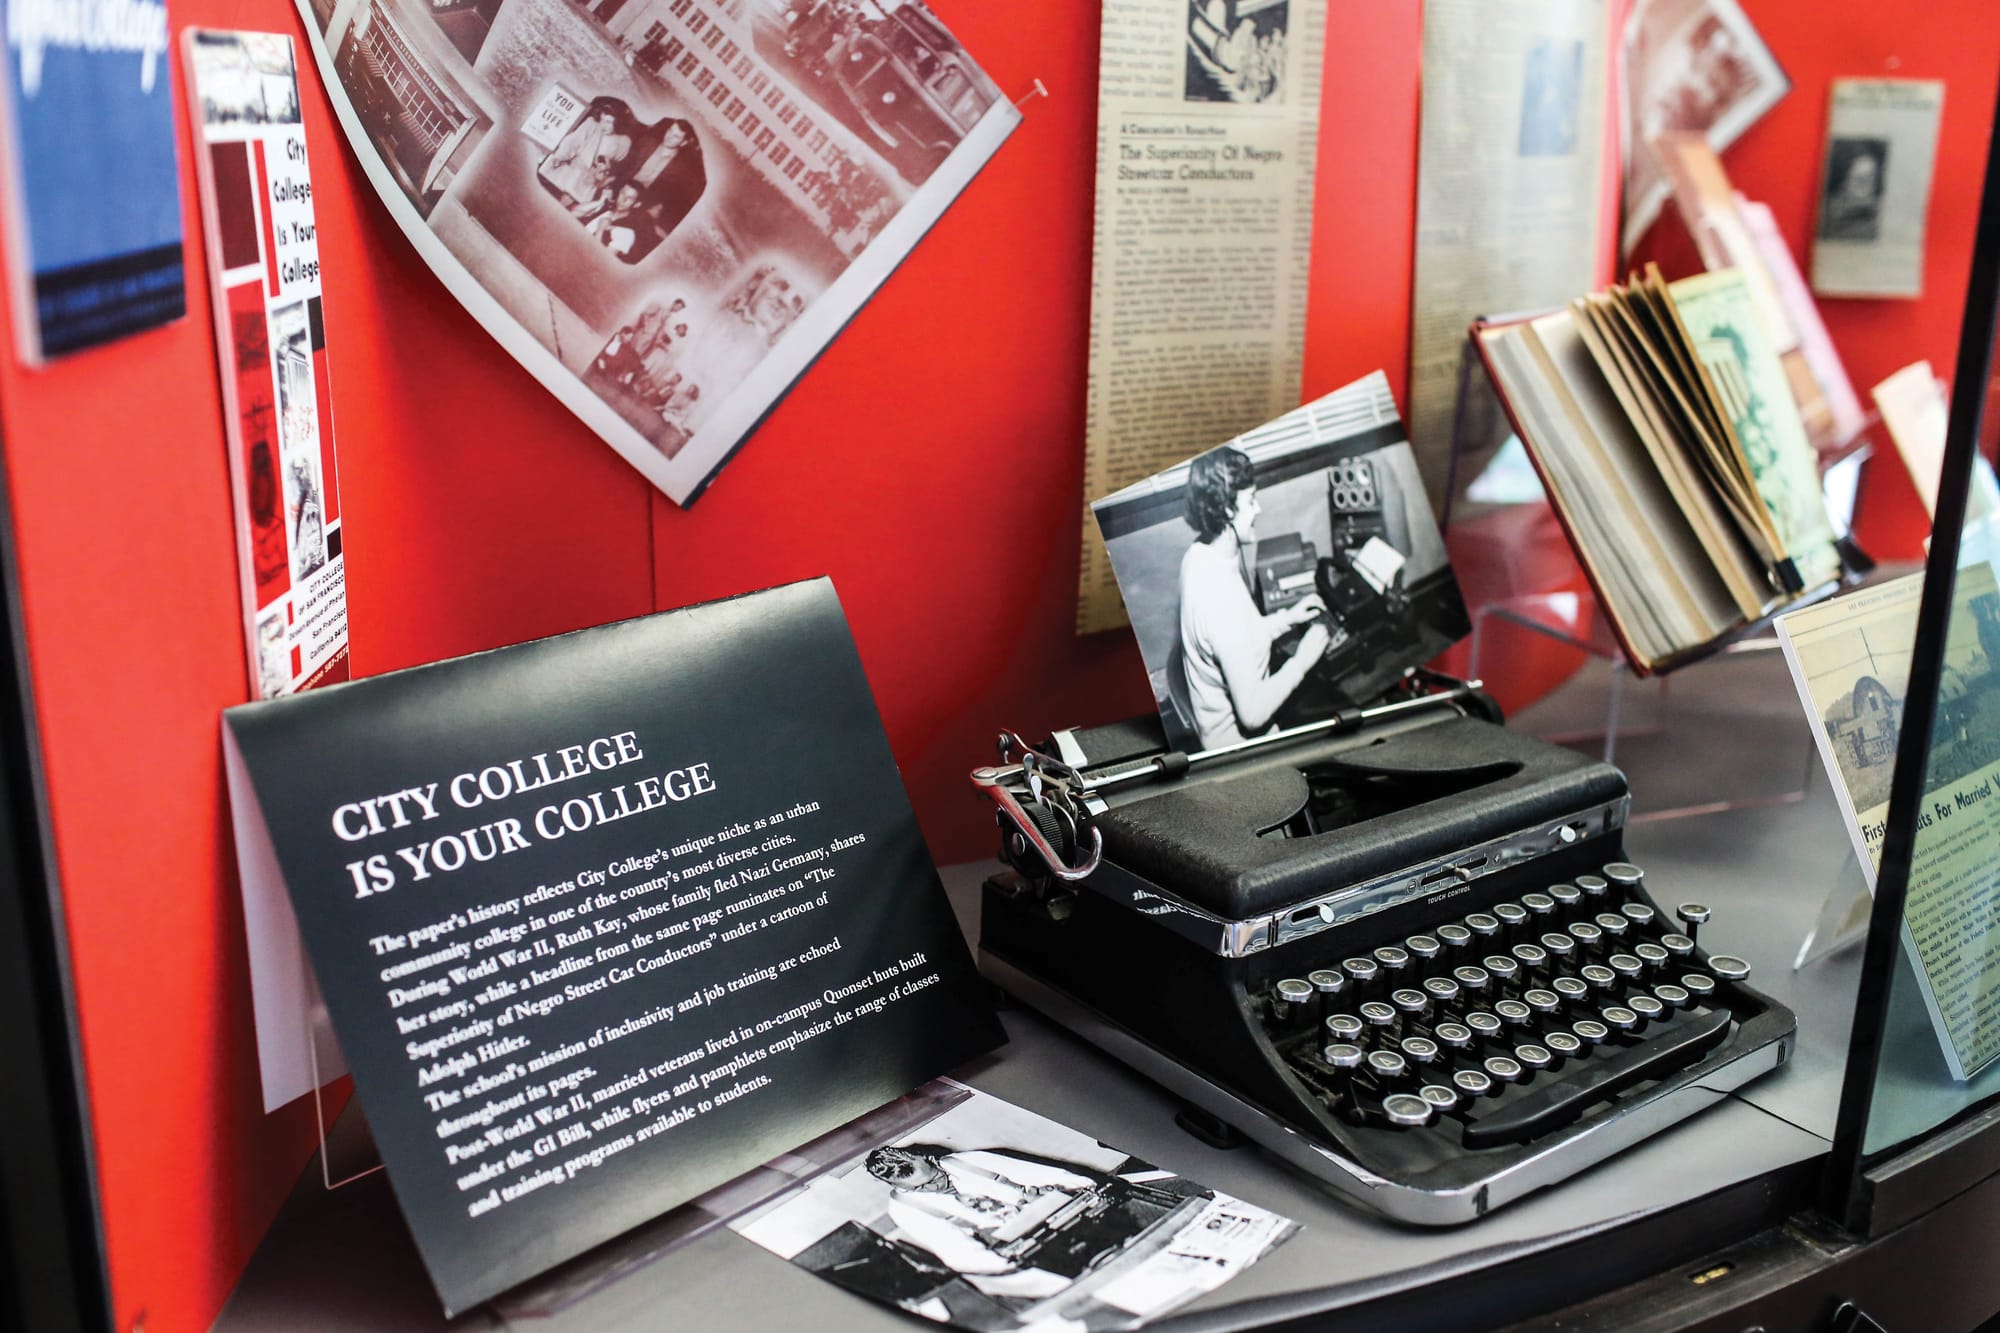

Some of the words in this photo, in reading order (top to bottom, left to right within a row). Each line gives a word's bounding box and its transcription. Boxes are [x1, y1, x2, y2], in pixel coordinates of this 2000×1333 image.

[542, 109, 562, 128] LIFE
[555, 92, 574, 111] YOU
[274, 177, 311, 204] College
[287, 138, 305, 165] City
[1119, 144, 1142, 159] The
[1146, 144, 1217, 163] Superiority
[277, 224, 287, 246] Is
[291, 221, 315, 243] Your
[282, 257, 319, 284] College
[332, 782, 440, 841] CITY
[450, 730, 643, 808] COLLEGE
[345, 854, 395, 899] IS
[395, 817, 532, 881] YOUR
[534, 762, 716, 840] COLLEGE
[1914, 812, 1933, 833] uts
[1934, 802, 1953, 821] For
[1954, 780, 1993, 811] Married
[368, 934, 406, 955] The
[466, 897, 520, 924] history
[522, 880, 576, 906] reflects
[576, 869, 606, 887] City
[670, 835, 716, 857] unique
[716, 822, 752, 842] niche
[753, 818, 767, 830] as
[768, 813, 785, 825] an
[785, 801, 820, 819] urban
[387, 977, 451, 1008] During
[447, 956, 500, 985] World
[497, 948, 533, 967] War
[532, 938, 556, 957] II,
[554, 925, 594, 949] Ruth
[592, 917, 627, 936] Kay,
[626, 901, 671, 923] whose
[671, 884, 711, 909] family
[713, 873, 739, 894] fled
[737, 862, 771, 884] Nazi
[771, 847, 830, 872] Germany,
[830, 833, 866, 852] shares
[473, 923, 528, 950] college
[528, 915, 547, 931] in
[547, 907, 576, 924] one
[577, 896, 593, 914] of
[593, 892, 618, 909] the
[681, 859, 715, 880] most
[715, 846, 759, 868] diverse
[760, 834, 796, 852] cities.
[1428, 893, 1447, 905] TOUCH
[1447, 885, 1471, 898] CONTROL
[396, 1013, 427, 1034] her
[428, 999, 475, 1023] story,
[474, 980, 518, 1005] while
[519, 977, 531, 990] a
[529, 955, 594, 986] headline
[595, 942, 630, 963] from
[630, 933, 654, 949] the
[655, 920, 691, 941] same
[691, 908, 724, 932] page
[725, 886, 786, 915] ruminates
[787, 879, 805, 892] on
[405, 1018, 494, 1060] Superiority
[496, 1006, 514, 1026] of
[512, 993, 564, 1020] Negro
[564, 975, 608, 1001] Street
[608, 967, 635, 984] Car
[720, 921, 758, 942] under
[759, 918, 769, 928] a
[769, 900, 815, 924] cartoon
[815, 890, 829, 906] of
[418, 1051, 478, 1087] Adolph
[476, 1035, 531, 1063] Hitler.
[423, 1090, 461, 1112] The
[527, 1041, 587, 1073] mission
[587, 1028, 604, 1048] of
[604, 1005, 674, 1042] inclusivity
[677, 991, 703, 1013] and
[702, 983, 725, 1006] job
[726, 965, 778, 992] training
[778, 957, 798, 972] are
[799, 936, 842, 963] echoed
[444, 1114, 536, 1165] Post-World
[533, 1104, 569, 1125] War
[568, 1093, 592, 1112] II,
[591, 1067, 649, 1103] married
[648, 1047, 705, 1078] veterans
[704, 1029, 739, 1055] lived
[738, 1026, 755, 1041] in
[755, 998, 823, 1033] on-campus
[823, 975, 874, 1004] Quonset
[872, 965, 899, 983] huts
[898, 952, 927, 972] built
[435, 1092, 526, 1138] throughout
[525, 1084, 548, 1102] its
[547, 1066, 597, 1097] pages.
[456, 1160, 506, 1191] under
[505, 1149, 533, 1169] the
[533, 1134, 557, 1156] GI
[556, 1121, 592, 1147] Bill,
[590, 1105, 632, 1131] while
[632, 1090, 671, 1115] flyers
[672, 1073, 700, 1097] and
[699, 1048, 767, 1089] pamphlets
[768, 1020, 833, 1055] emphasize
[833, 1011, 853, 1026] the
[854, 996, 887, 1017] range
[888, 985, 901, 1001] of
[902, 973, 940, 996] classes
[467, 1188, 501, 1217] and
[500, 1165, 566, 1202] training
[563, 1134, 635, 1178] programs
[635, 1105, 696, 1142] available
[696, 1100, 712, 1113] to
[713, 1074, 772, 1106] students.
